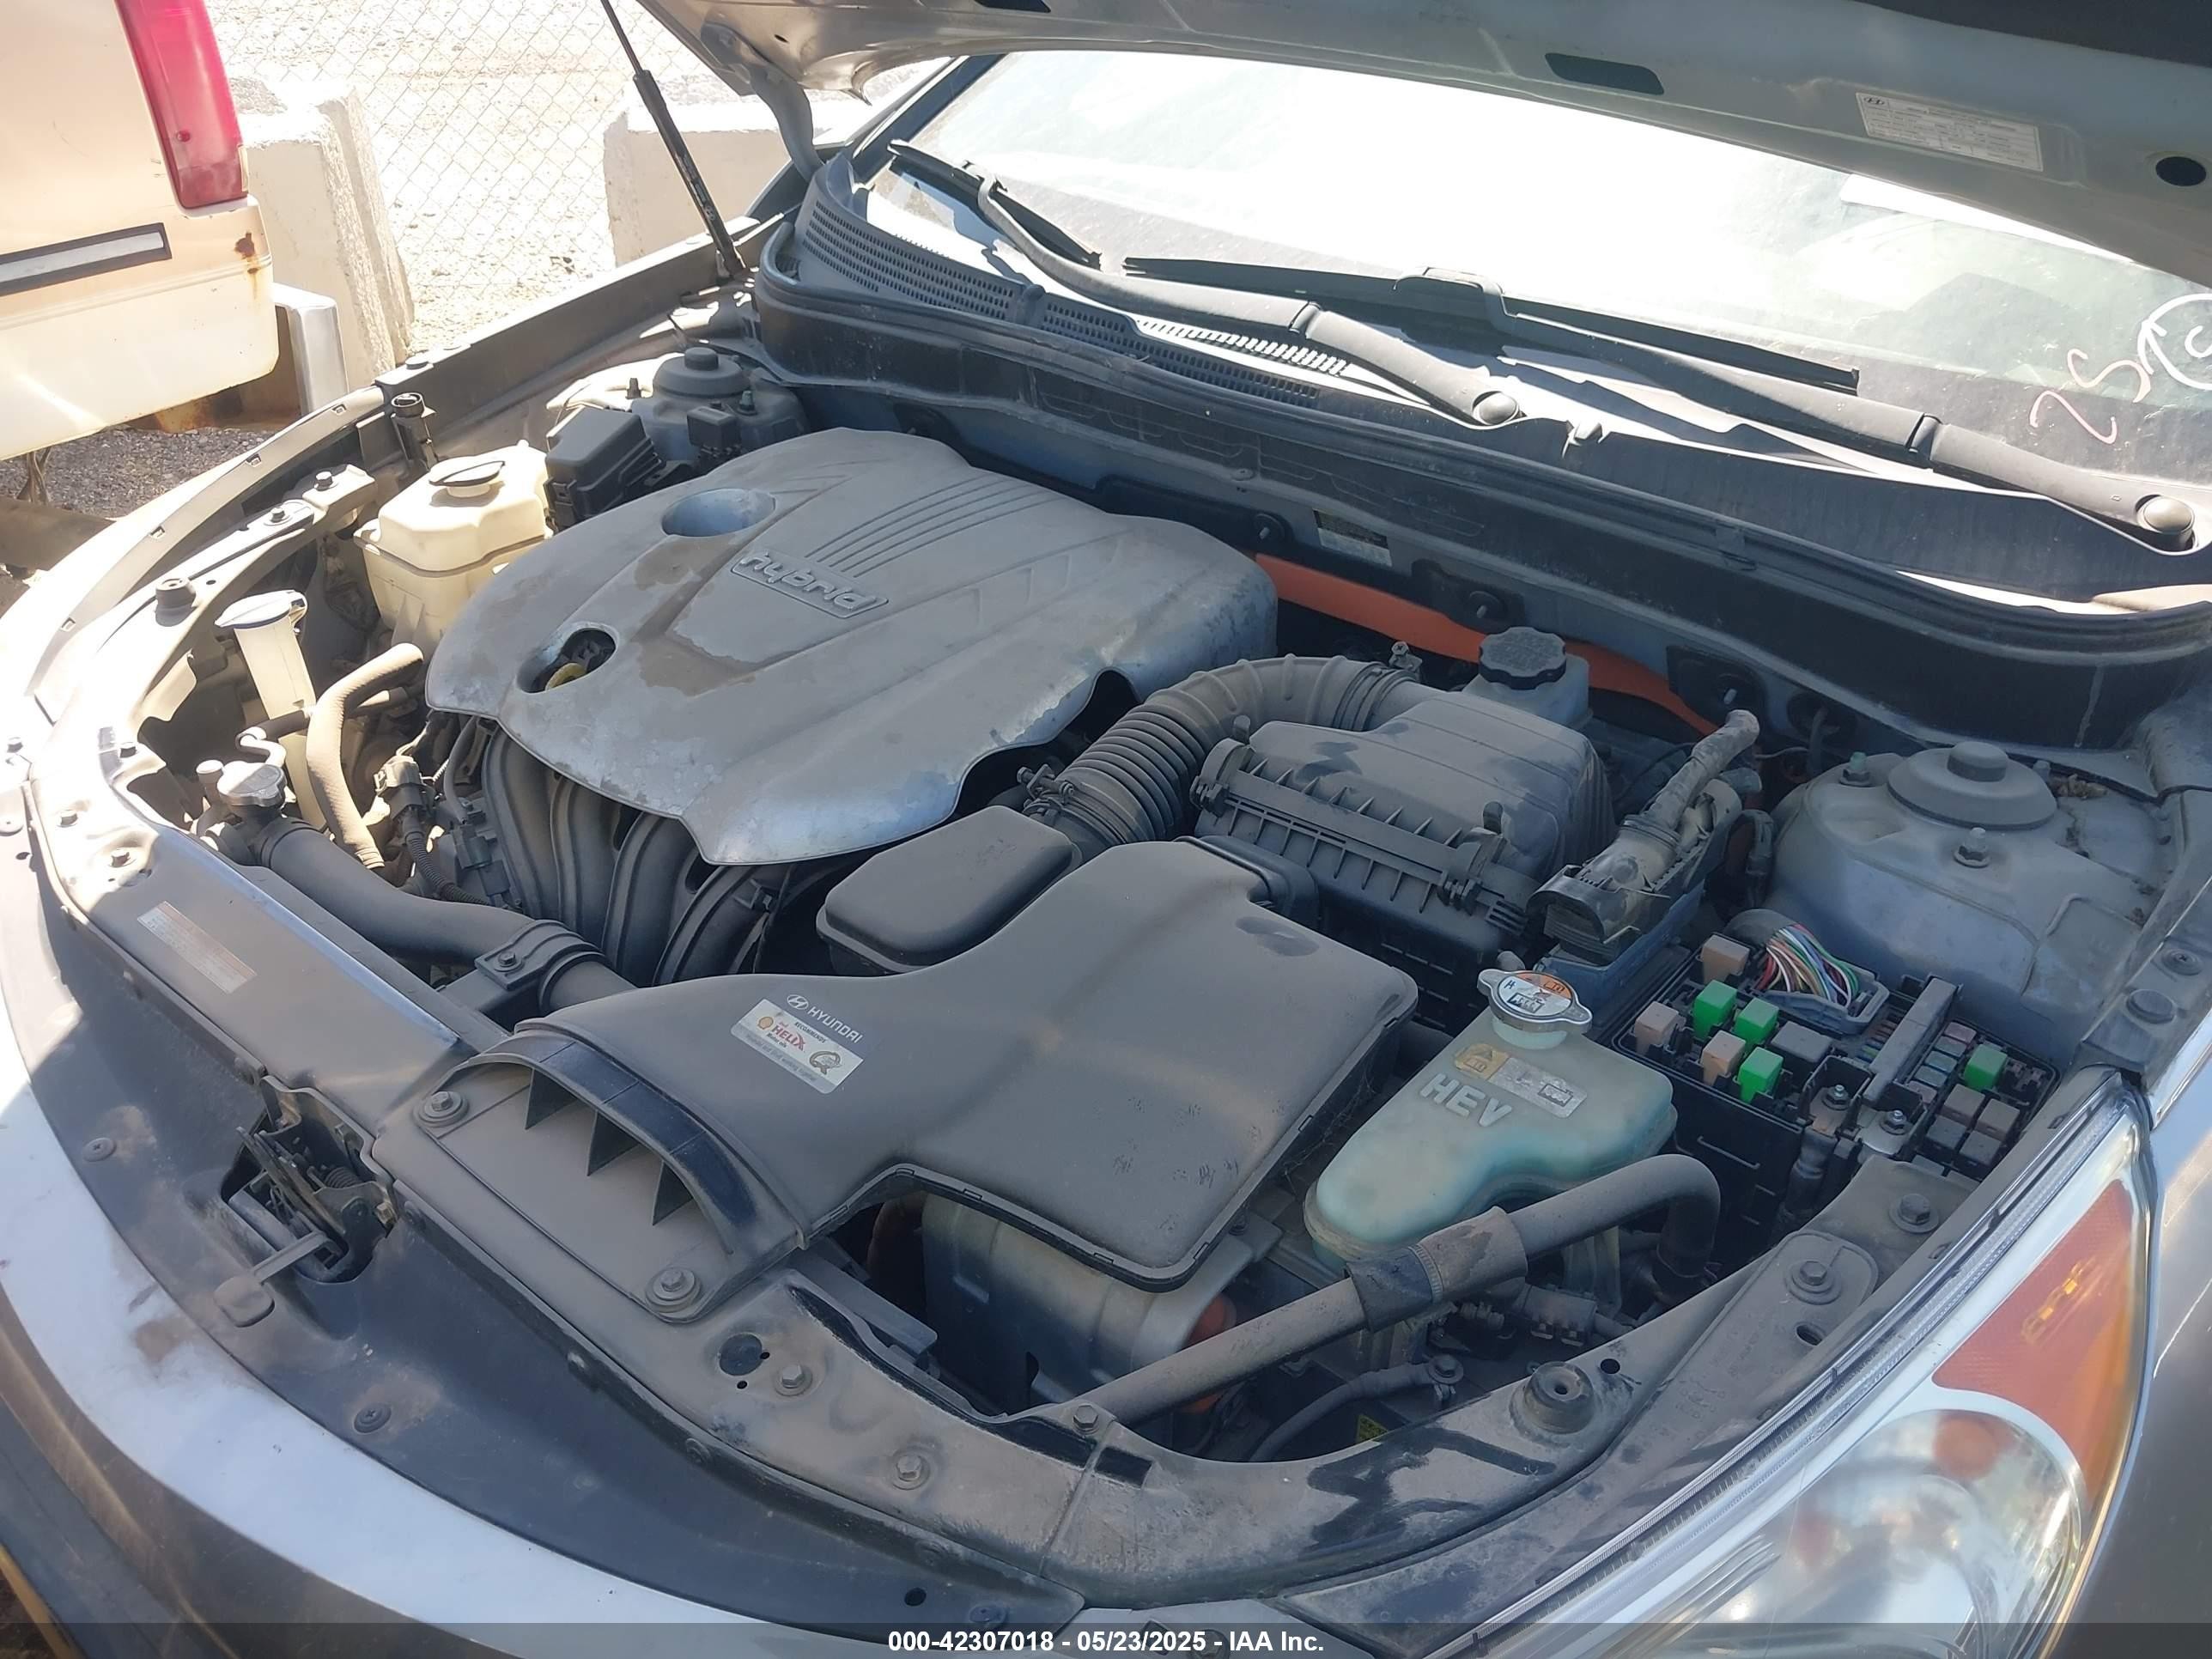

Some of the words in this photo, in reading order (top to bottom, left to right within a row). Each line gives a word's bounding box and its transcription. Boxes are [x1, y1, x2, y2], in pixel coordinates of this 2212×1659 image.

[739, 550, 878, 610] hybrid
[772, 1024, 805, 1052] HELIX
[794, 1021, 826, 1043] RECOMMENDS
[807, 1006, 863, 1043] HYUNDAI
[1419, 1073, 1512, 1127] HEV
